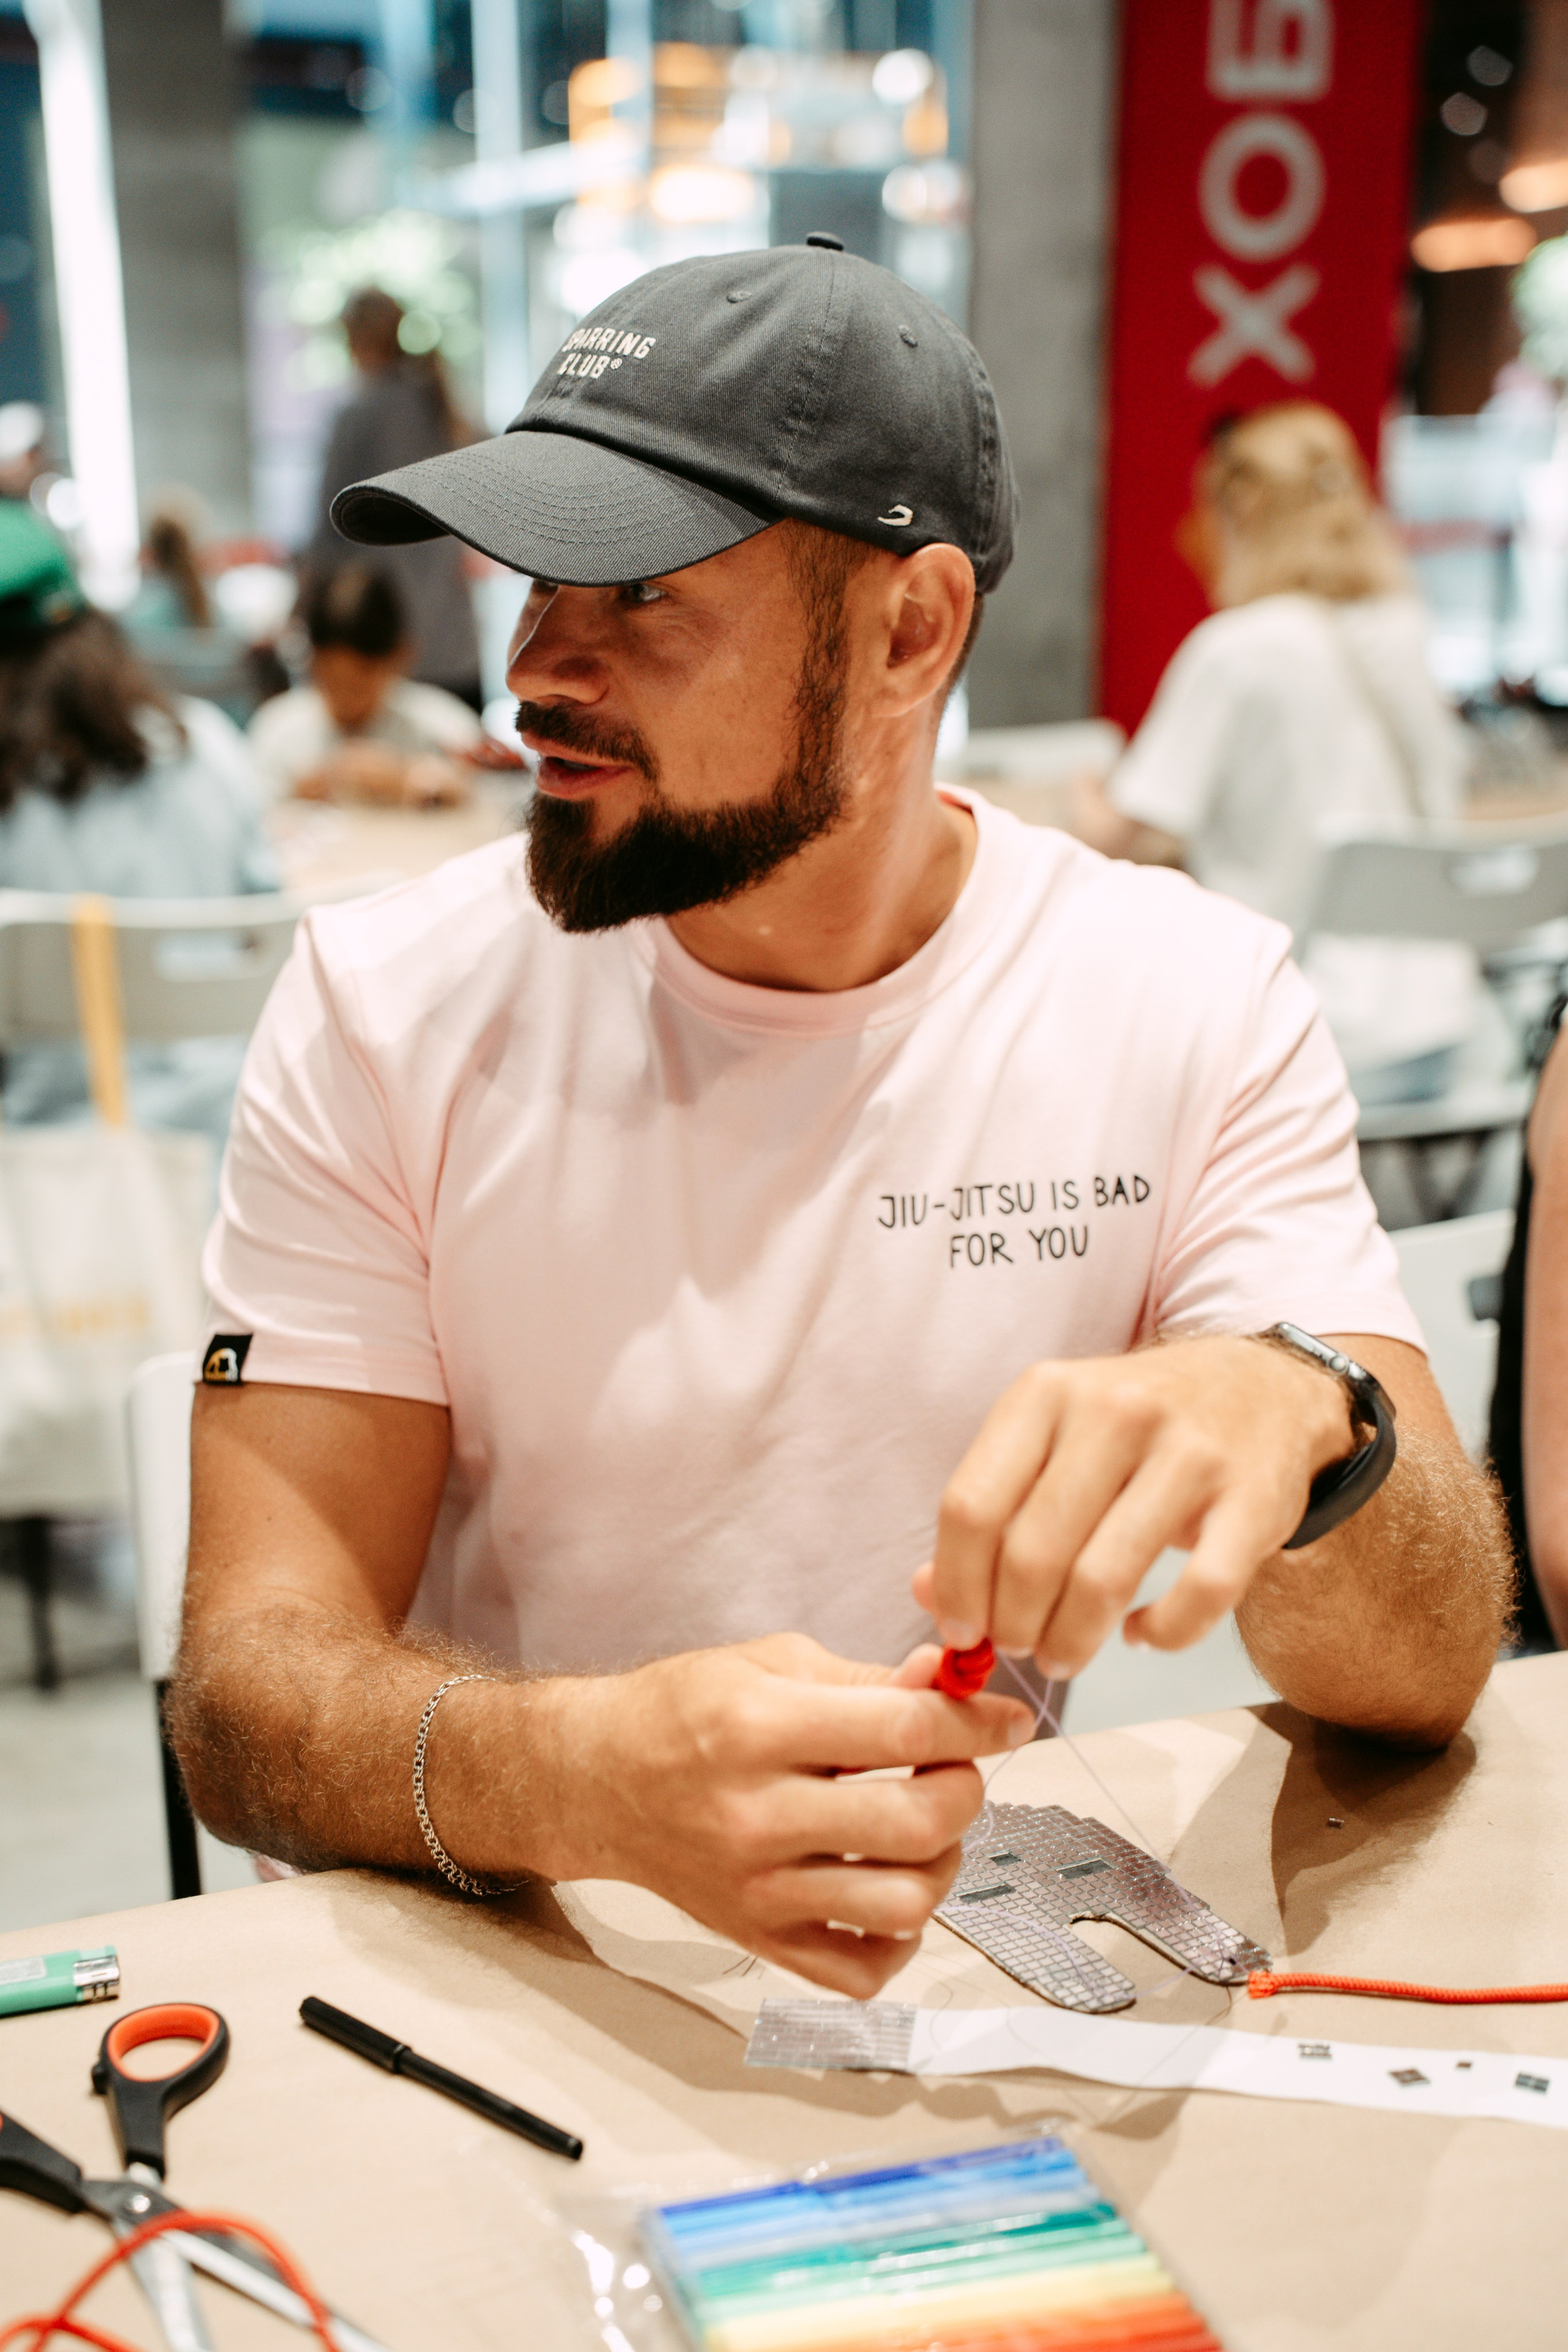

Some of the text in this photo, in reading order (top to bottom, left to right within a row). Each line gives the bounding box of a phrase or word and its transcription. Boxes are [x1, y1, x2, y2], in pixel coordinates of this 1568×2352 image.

[878, 1174, 1150, 1229] JIU-JITSU IS BAD
[949, 1224, 1089, 1268] FOR YOU
